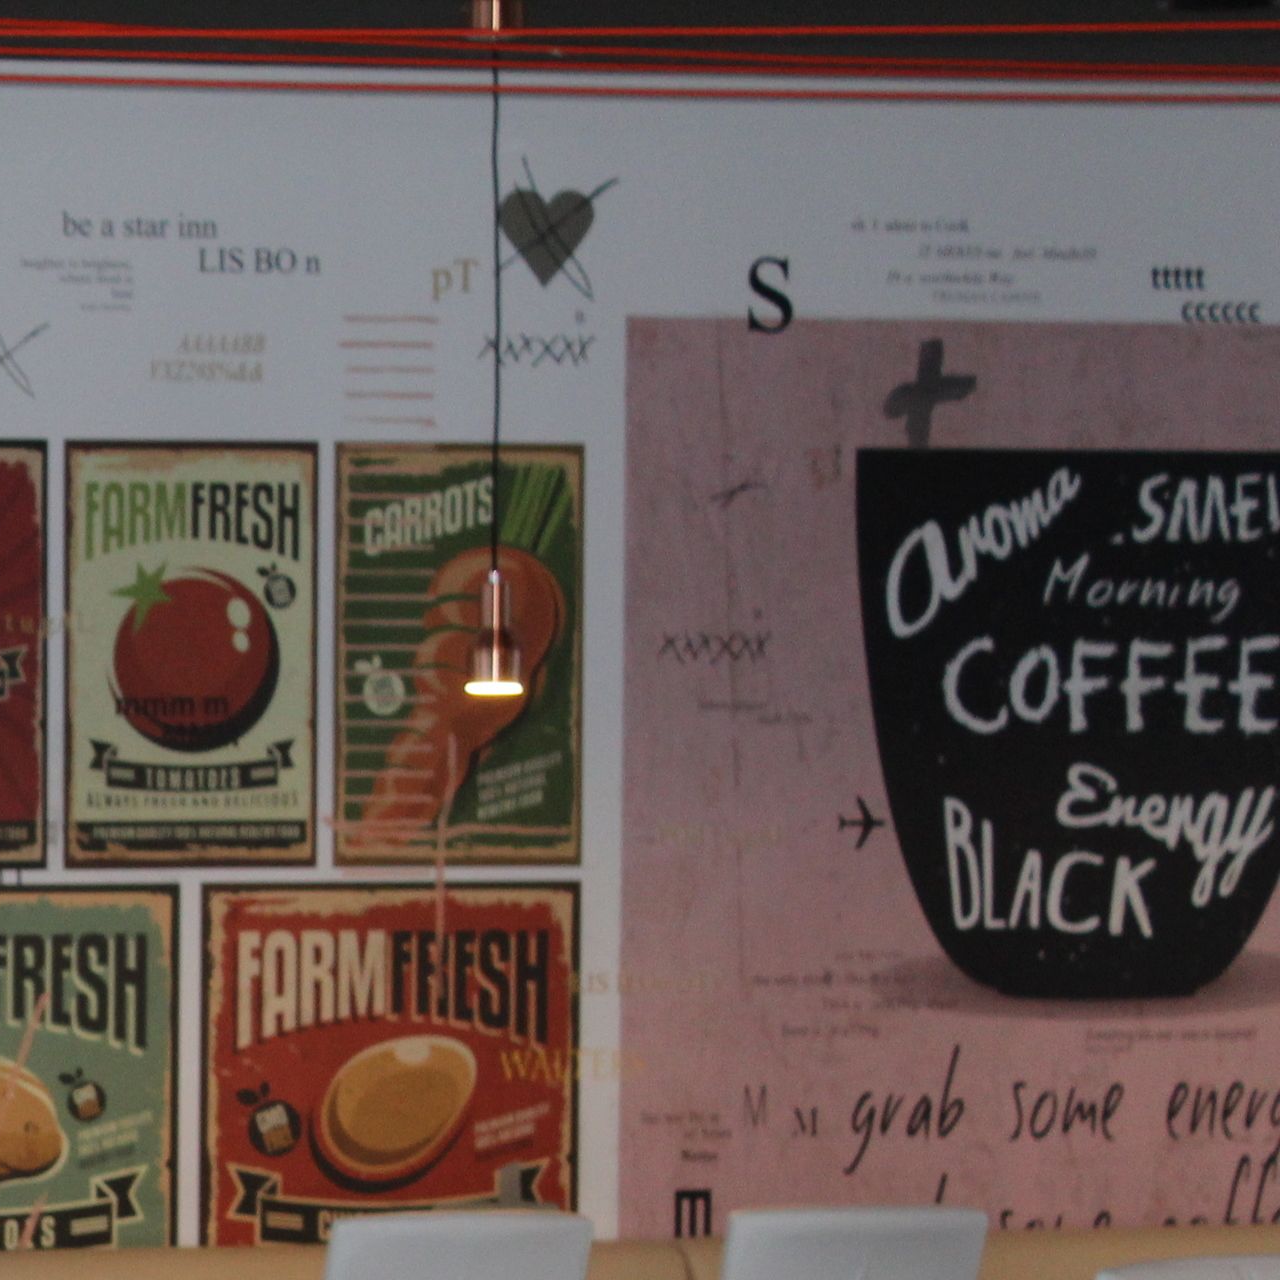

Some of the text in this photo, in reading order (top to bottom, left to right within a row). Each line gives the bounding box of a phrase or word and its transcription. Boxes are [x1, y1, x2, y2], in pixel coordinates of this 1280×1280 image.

[62, 209, 219, 239] be a star inn
[198, 246, 245, 275] LIS
[746, 255, 794, 335] S
[363, 475, 495, 557] CARROTS
[1044, 551, 1241, 624] Morning
[943, 634, 1280, 734] COFFEE
[943, 796, 1156, 938] BLACK
[1055, 761, 1277, 908] Energy
[843, 1043, 966, 1175] grab
[1009, 1081, 1125, 1143] some
